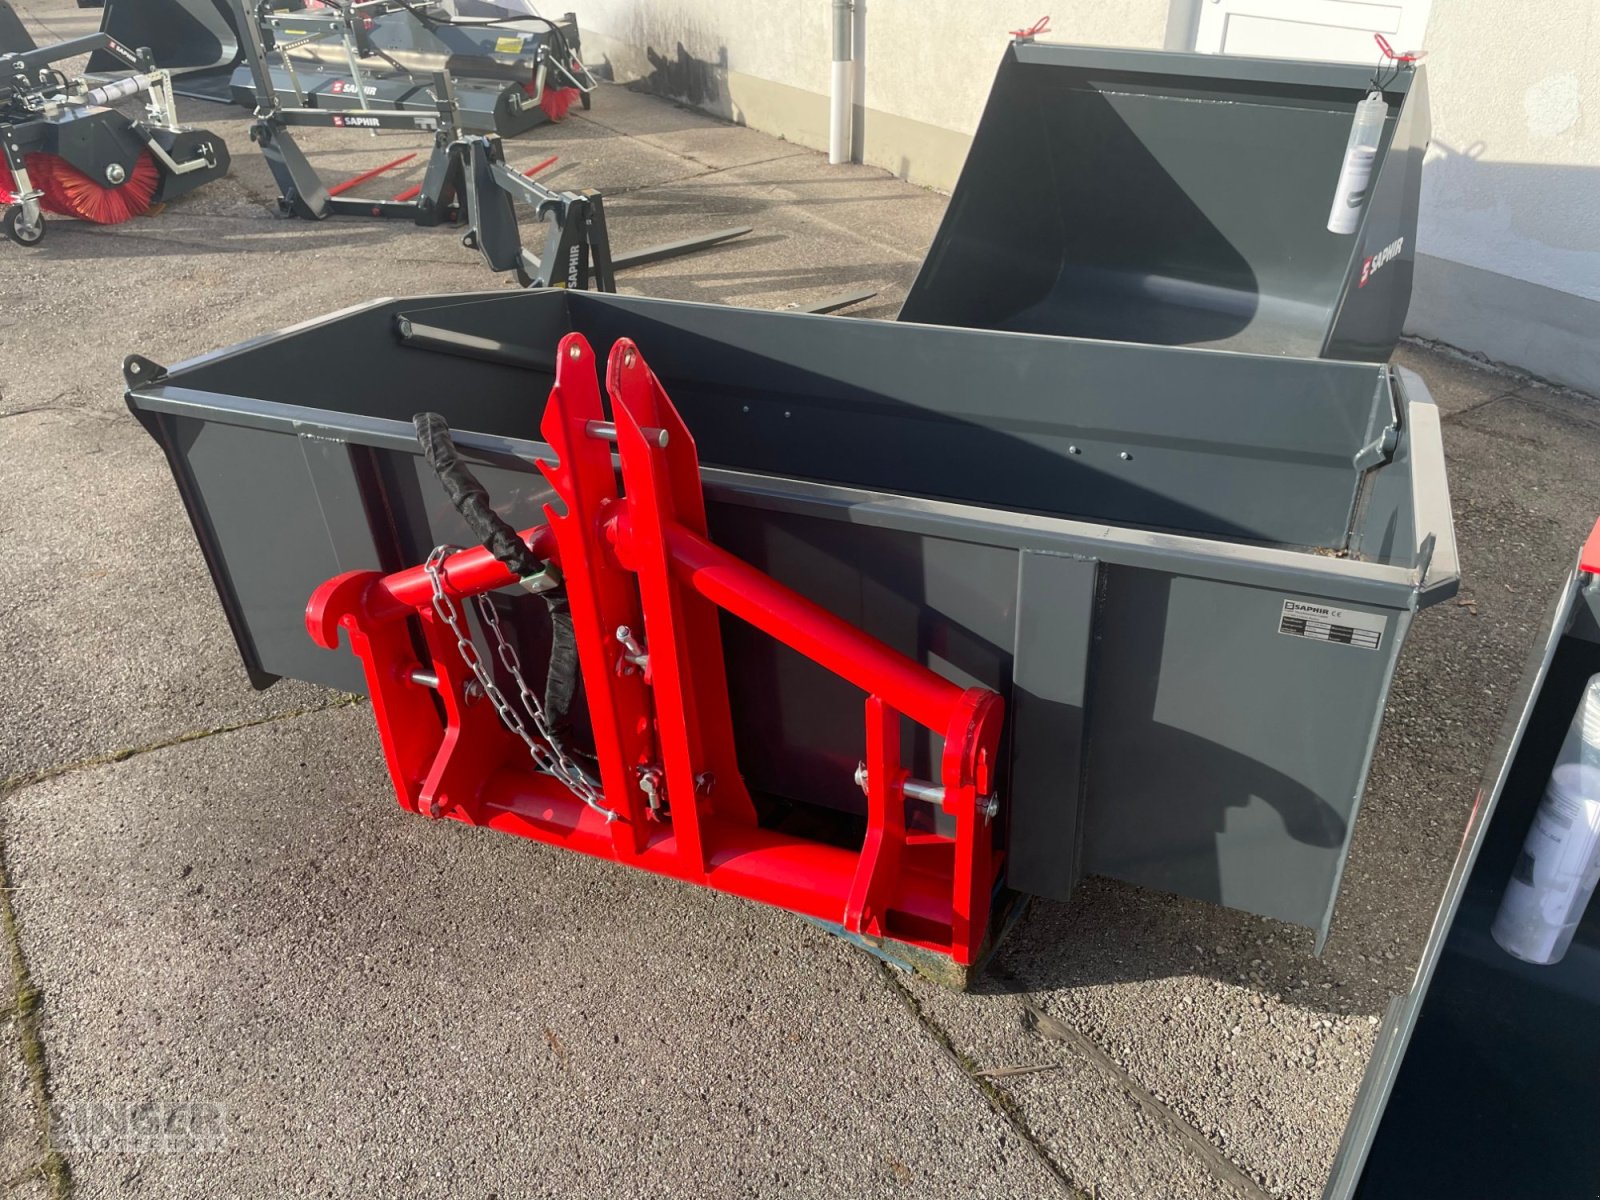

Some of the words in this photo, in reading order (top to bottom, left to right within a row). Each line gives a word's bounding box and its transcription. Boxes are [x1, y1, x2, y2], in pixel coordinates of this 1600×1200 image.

[344, 117, 380, 126] SAPHIR
[568, 244, 580, 288] SAPHIR
[1370, 236, 1403, 275] SAPHIR
[1295, 604, 1329, 615] SAPHIR
